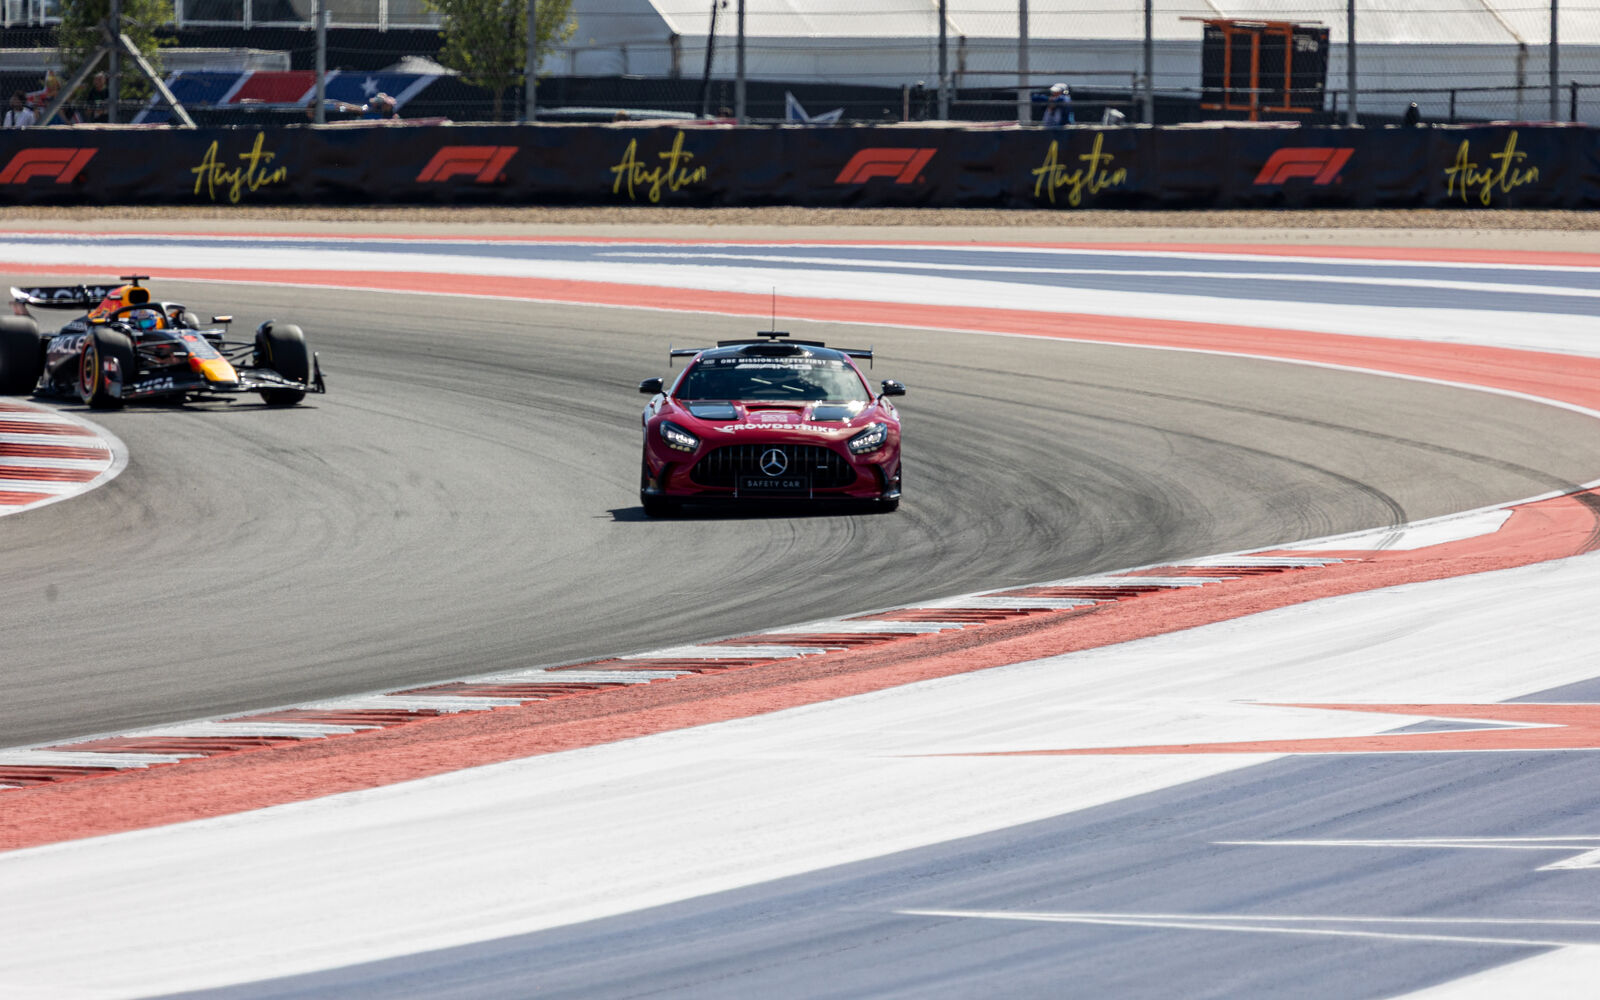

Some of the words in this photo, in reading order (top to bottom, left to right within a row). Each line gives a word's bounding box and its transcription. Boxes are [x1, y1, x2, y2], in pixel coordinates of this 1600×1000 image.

[191, 131, 288, 204] Austin
[417, 146, 518, 182] F1
[610, 131, 707, 203] Austin
[835, 147, 937, 184] F1
[1032, 132, 1127, 206] Austin
[1254, 147, 1355, 185] F1
[1444, 130, 1540, 206] Austin
[721, 422, 838, 433] CROWDSTRIKE
[747, 480, 779, 488] SAFETY
[782, 480, 801, 488] CAR
